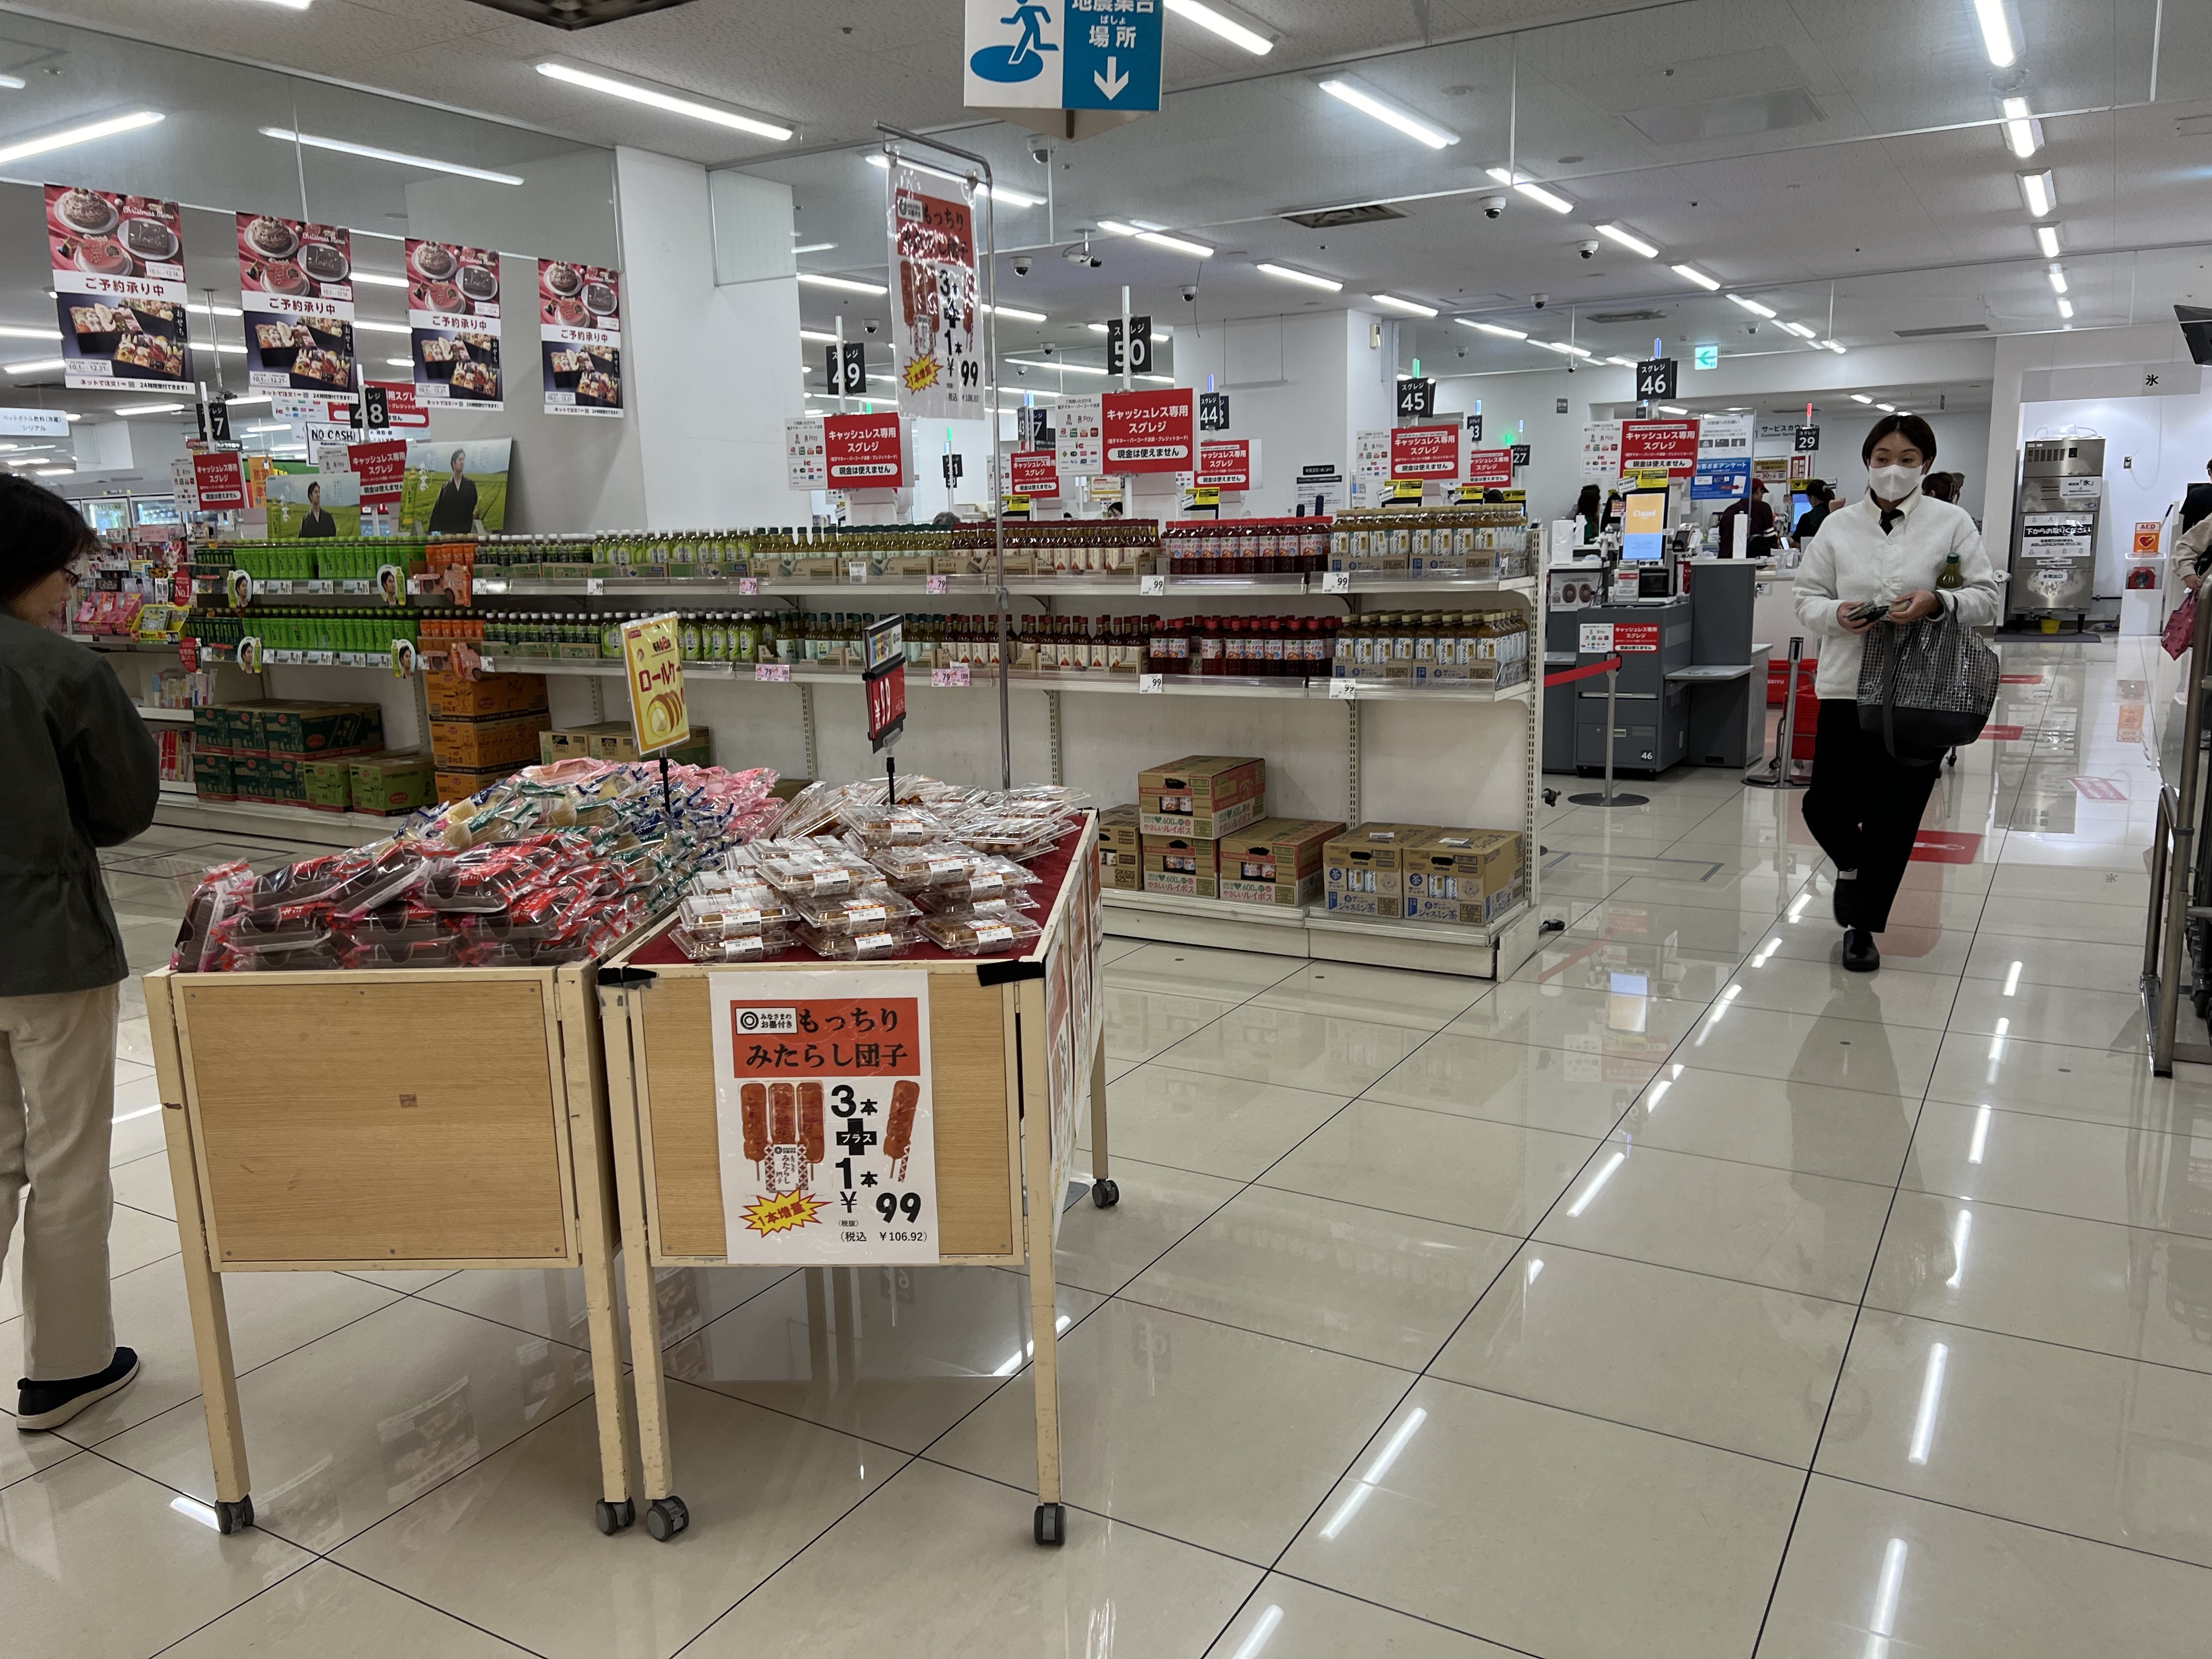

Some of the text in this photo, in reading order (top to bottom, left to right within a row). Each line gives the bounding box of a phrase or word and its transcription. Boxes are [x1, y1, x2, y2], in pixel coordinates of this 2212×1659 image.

[1100, 15, 1126, 25] ばしょ
[1088, 25, 1136, 48] 場所
[85, 276, 165, 296] ご予約承り中
[269, 298, 336, 315] ご予約承り中
[432, 315, 487, 331] ご予約承り中
[1114, 323, 1145, 336] スレジ
[561, 330, 608, 342] ご予約承り中
[944, 330, 963, 356] 1本
[832, 348, 859, 360] スレジ
[1114, 338, 1145, 367] 50
[961, 360, 979, 387] 99
[1641, 363, 1666, 374] スグレジ
[1640, 373, 1666, 395] 46
[2145, 374, 2159, 386] 氷
[1402, 382, 1424, 391] スグレジ
[1201, 397, 1217, 405] スグレジ
[1401, 392, 1425, 411] 45
[1107, 405, 1189, 420] キャッシュレス専用
[1200, 406, 1218, 424] 44
[1018, 419, 1025, 435] 43
[1128, 421, 1167, 434] スグレジ
[312, 429, 324, 440] NO
[828, 427, 896, 441] キャッシュレス専用
[1626, 431, 1695, 441] キャッシュレス専用
[1395, 435, 1455, 446] キャッシュレス専用
[1643, 441, 1677, 450] スグレジ
[1798, 437, 1816, 449] 29
[848, 441, 879, 453] スグレジ
[1410, 446, 1439, 455] スグレジ
[353, 452, 406, 465] キャッシュレス専用
[1117, 448, 1180, 459] 現金は使えません
[1201, 450, 1246, 459] ャッシュレス専用
[1513, 453, 1527, 464] 27
[1013, 460, 1056, 469] キャッシュレス専用
[1402, 463, 1448, 472] 現金は使えません
[1633, 459, 1685, 467] 現金は使えません
[368, 464, 393, 475] スグレジ
[839, 465, 891, 475] 現金は使えません
[1633, 509, 1656, 517] Closed
[937, 580, 946, 588] 79
[1153, 580, 1163, 589] 99
[1337, 577, 1348, 586] 99
[1152, 678, 1161, 686] 99
[1345, 684, 1355, 692] 99
[1640, 752, 1653, 760] 46
[1143, 824, 1192, 836] やさしいルイボス
[1412, 873, 1421, 885] 茶
[1148, 881, 1194, 894] やさしいルイボス
[1223, 890, 1273, 902] やさしいルイボス
[1339, 902, 1376, 914] ジャスミン茶
[1418, 909, 1459, 920] ジャスミン茶
[760, 1020, 793, 1029] お墨付き
[799, 1007, 898, 1032] もっちり
[746, 1042, 907, 1068] みたらし団子
[831, 1085, 878, 1118] 3本
[840, 1133, 872, 1143] プラス
[782, 1155, 791, 1184] みたらし
[835, 1158, 878, 1189] 1本
[756, 1200, 806, 1227] 1本増量
[840, 1192, 921, 1224] ¥ 99
[838, 1220, 859, 1228] (税抜)
[840, 1231, 927, 1243] (税込 ¥106.92)
